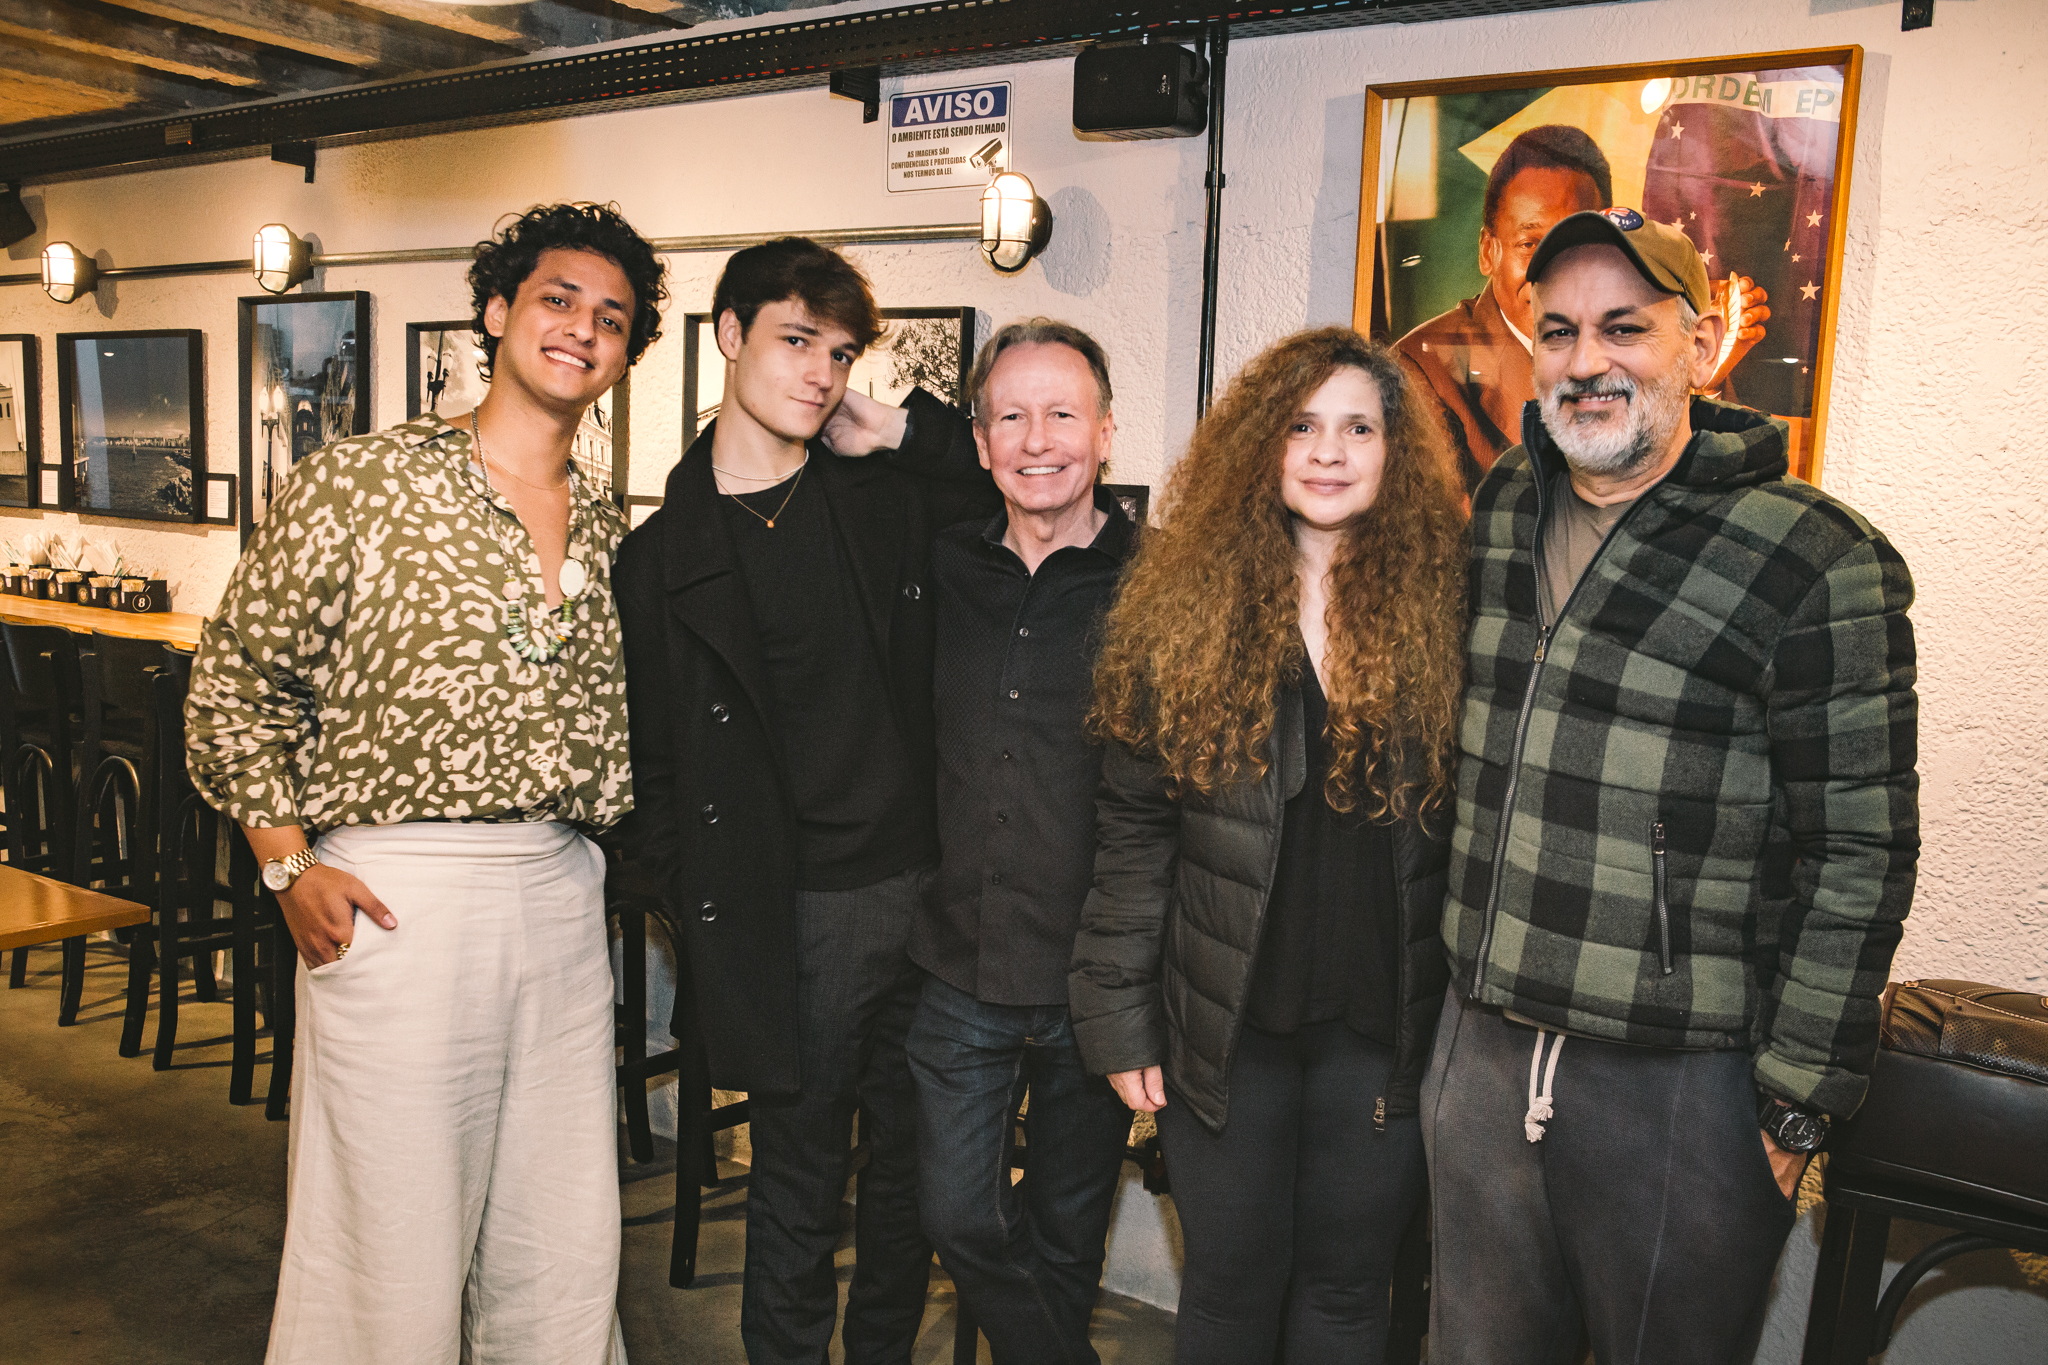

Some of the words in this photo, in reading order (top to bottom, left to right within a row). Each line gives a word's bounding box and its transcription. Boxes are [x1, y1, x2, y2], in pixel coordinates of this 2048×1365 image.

[904, 90, 995, 124] AVISO
[892, 133, 897, 143] O
[897, 129, 932, 143] AMBIENTE
[932, 126, 949, 139] ESTÁ
[950, 125, 974, 137] SENDO
[974, 122, 1006, 135] FILMADO
[915, 148, 938, 158] IMAGENS
[939, 146, 950, 156] SÃO
[891, 159, 929, 170] CONFIDENCIAIS
[930, 159, 934, 167] E
[934, 156, 967, 166] PROTEGIDAS
[903, 170, 914, 179] NOS
[914, 169, 936, 177] TERMOS
[936, 168, 944, 176] DA
[138, 597, 146, 608] 8
